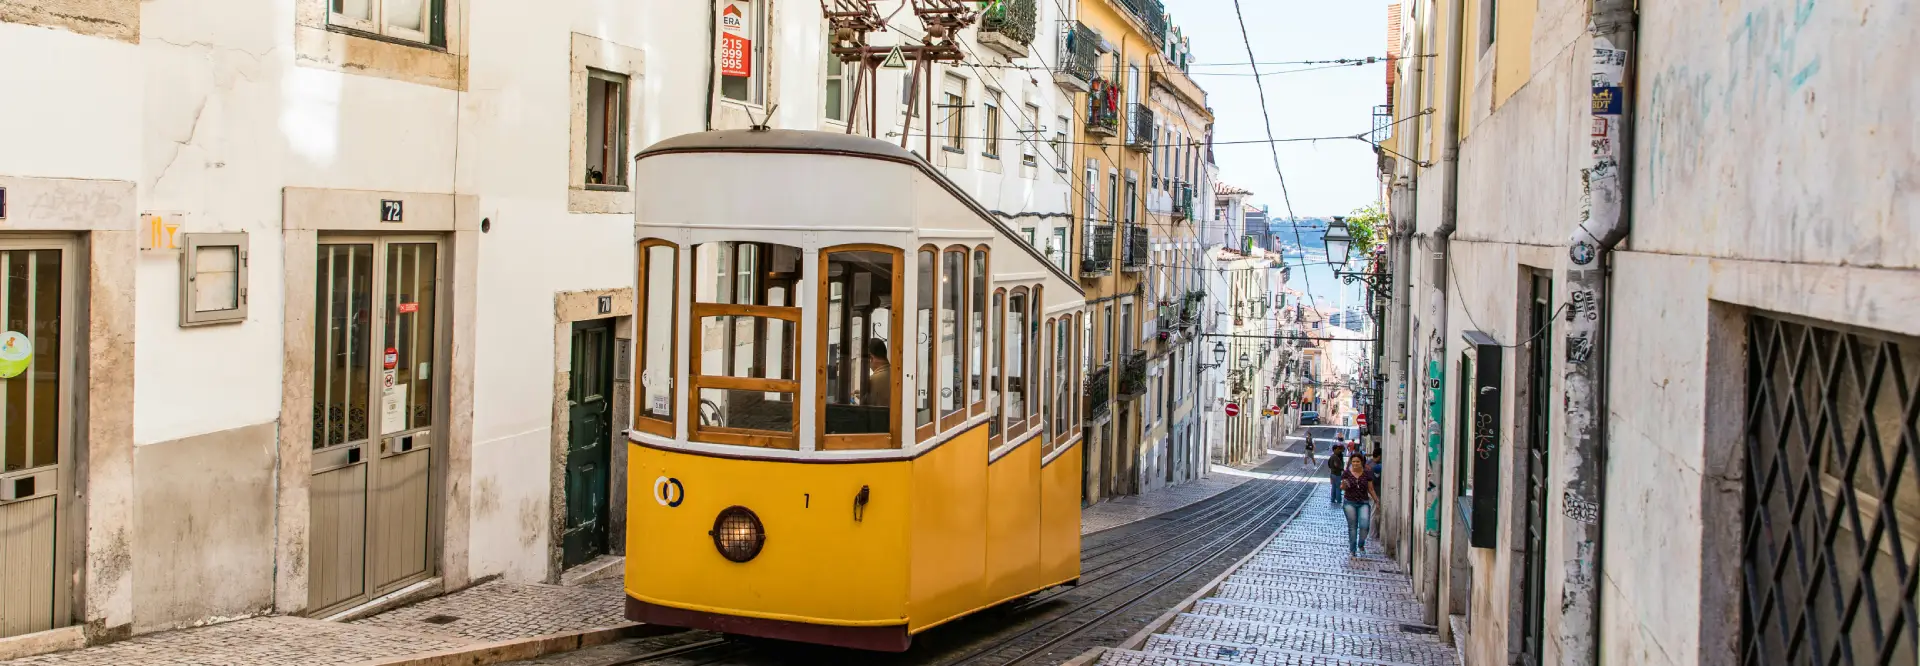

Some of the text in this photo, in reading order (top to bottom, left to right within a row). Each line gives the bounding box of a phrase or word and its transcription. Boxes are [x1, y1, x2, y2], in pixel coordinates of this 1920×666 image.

[723, 16, 741, 26] ERA
[722, 37, 742, 50] 215
[722, 48, 742, 60] 999
[722, 58, 742, 69] 995
[385, 201, 400, 221] 72
[804, 493, 810, 509] 1
